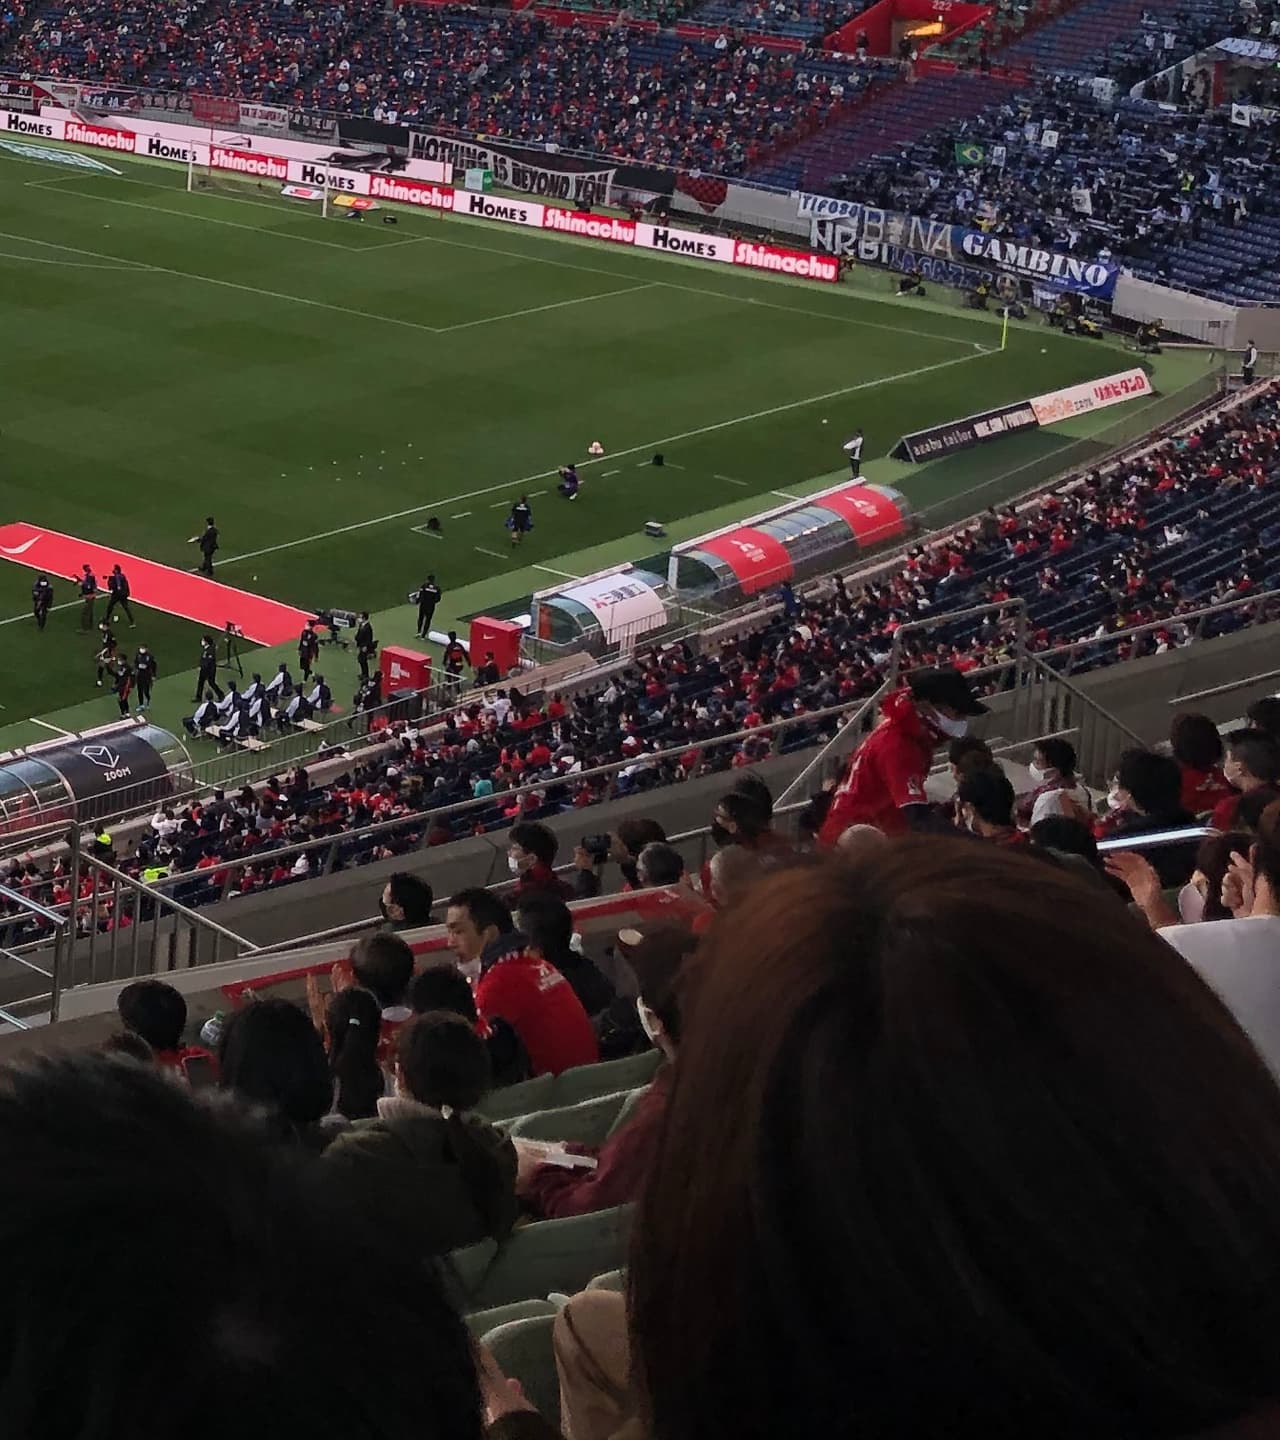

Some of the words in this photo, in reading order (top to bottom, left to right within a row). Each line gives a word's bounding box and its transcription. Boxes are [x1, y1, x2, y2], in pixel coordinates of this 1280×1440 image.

[65, 122, 134, 151] Shimachu
[211, 146, 288, 179] Shimachu
[412, 134, 488, 169] NOTHING
[492, 155, 508, 181] IS
[512, 161, 569, 198] BEYOND
[574, 173, 609, 203] YOU
[370, 175, 454, 209] Shimachu
[544, 208, 635, 242] Shimachu
[735, 244, 836, 280] Shimachu
[963, 233, 1109, 287] GAMBINO
[104, 766, 132, 782] ZOOM
